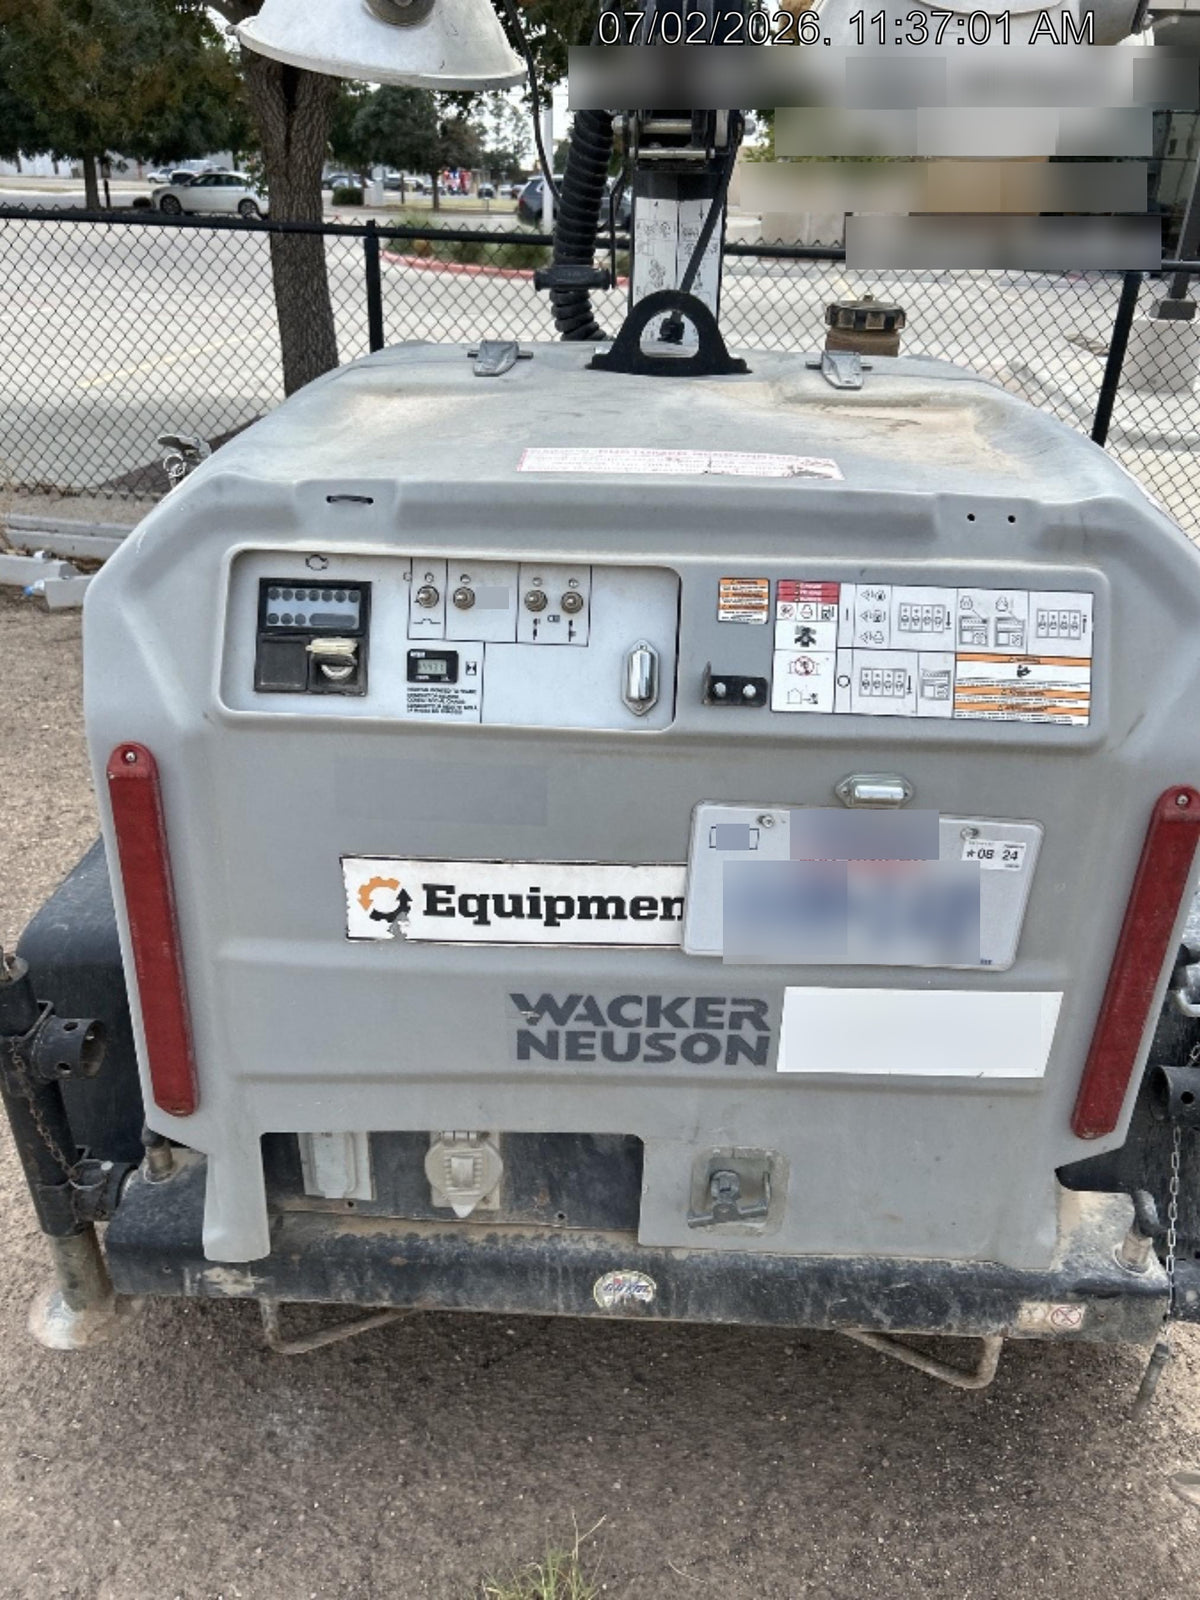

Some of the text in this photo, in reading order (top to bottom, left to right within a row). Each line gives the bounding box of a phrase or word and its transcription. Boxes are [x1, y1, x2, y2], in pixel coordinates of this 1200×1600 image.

[1002, 849, 1019, 861] 24
[421, 883, 685, 927] Equipmen
[509, 993, 771, 1031] WACKER
[516, 1029, 770, 1066] NEUSON
